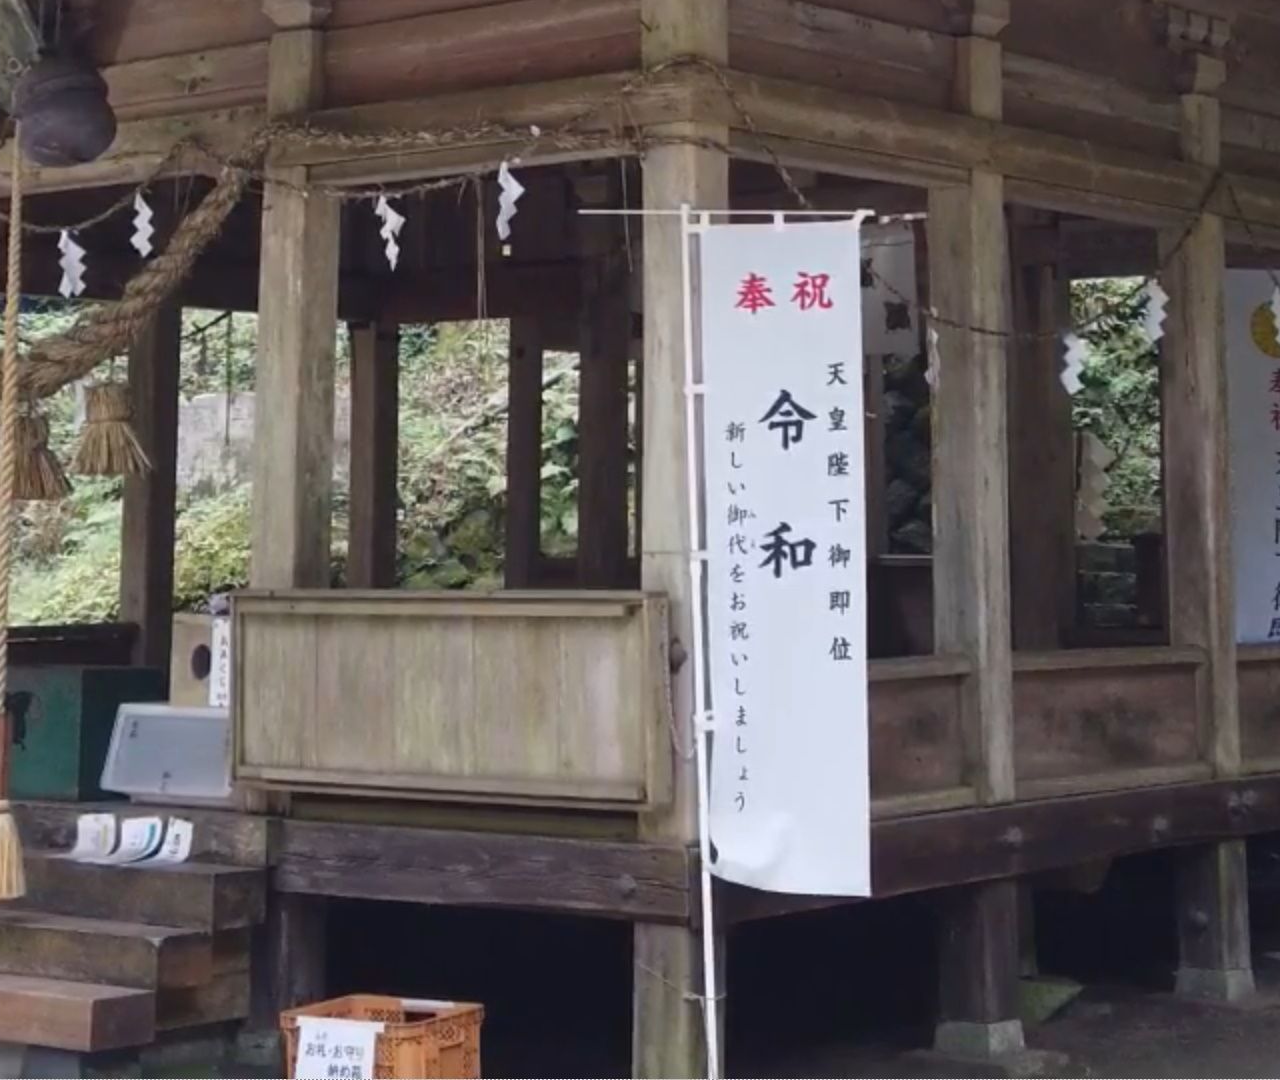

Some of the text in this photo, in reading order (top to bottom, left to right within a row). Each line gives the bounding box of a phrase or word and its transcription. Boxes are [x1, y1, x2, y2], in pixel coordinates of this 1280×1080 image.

[735, 271, 834, 314] 奉祝
[757, 389, 819, 579] 令和
[826, 362, 853, 661] 天皇陛下御即位
[724, 420, 749, 813] 新しい御代をお祝いしましょう
